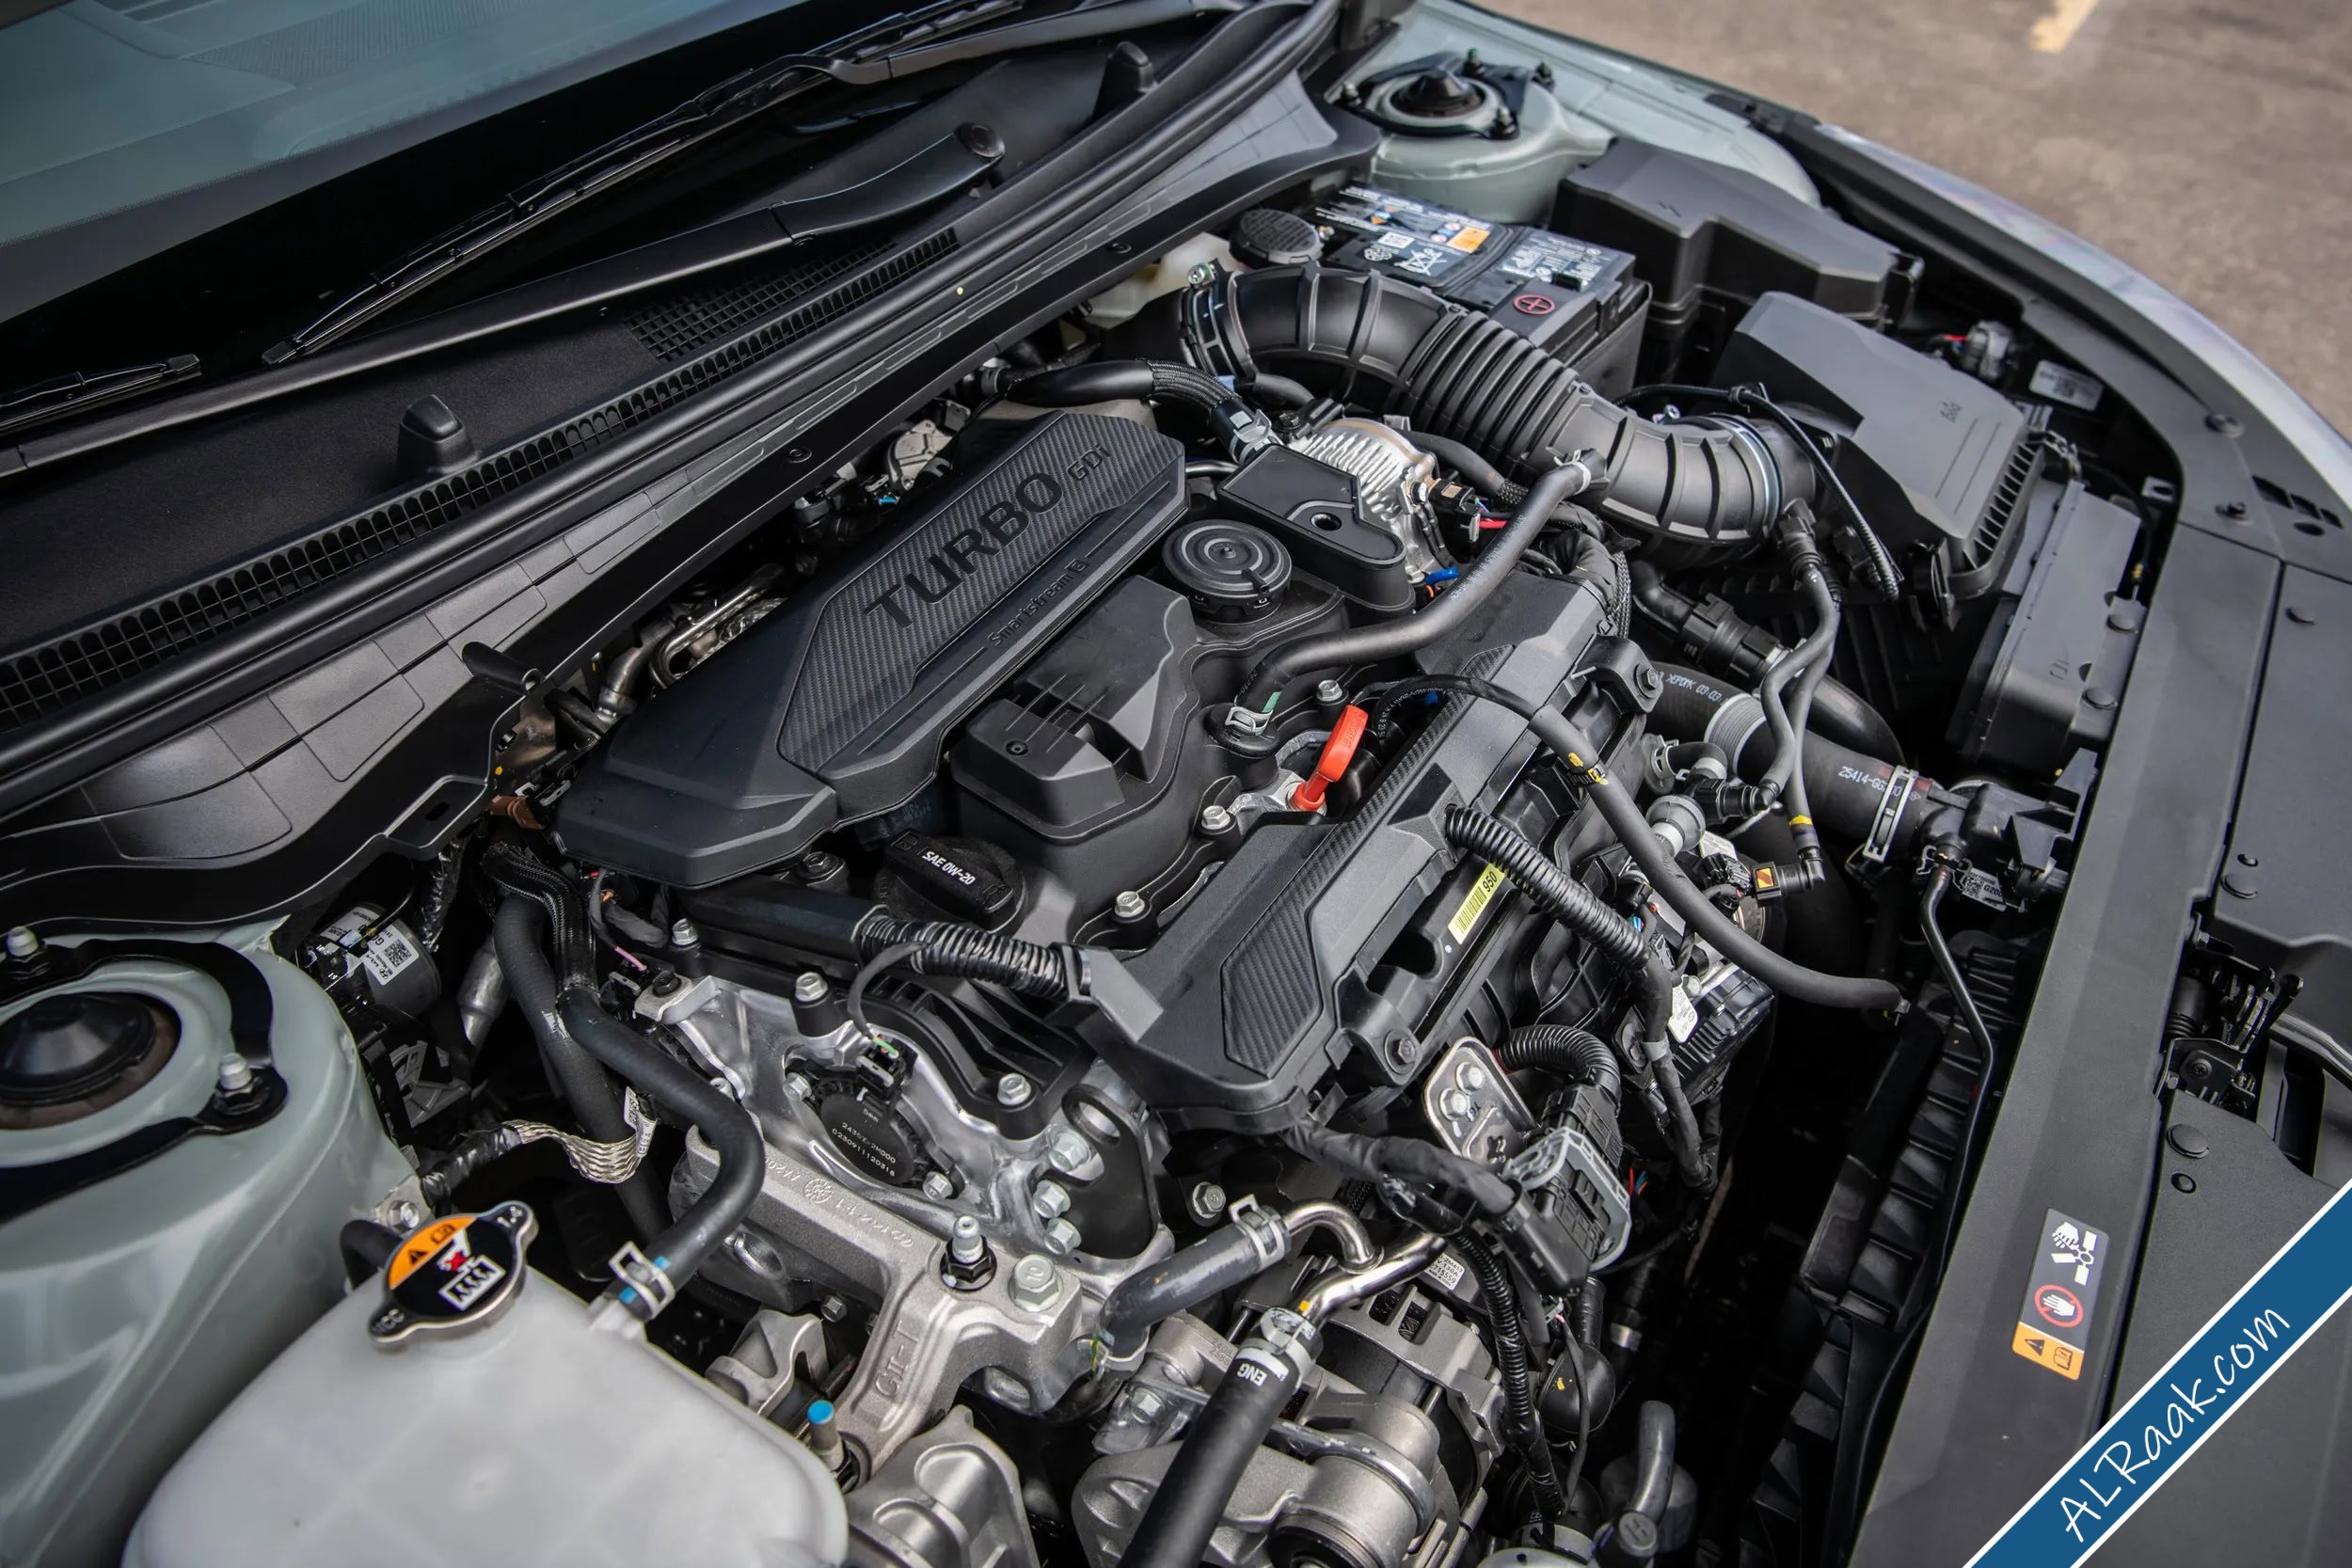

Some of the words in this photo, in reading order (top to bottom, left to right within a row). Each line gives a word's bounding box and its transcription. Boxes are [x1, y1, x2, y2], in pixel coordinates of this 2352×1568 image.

[863, 471, 1065, 630] TURBO
[1068, 443, 1112, 482] GDi
[987, 573, 1073, 646] Smartstream
[922, 850, 945, 868] SAE
[942, 861, 977, 885] 0W-20
[1482, 871, 1498, 893] 950
[1237, 1363, 1268, 1386] ENG
